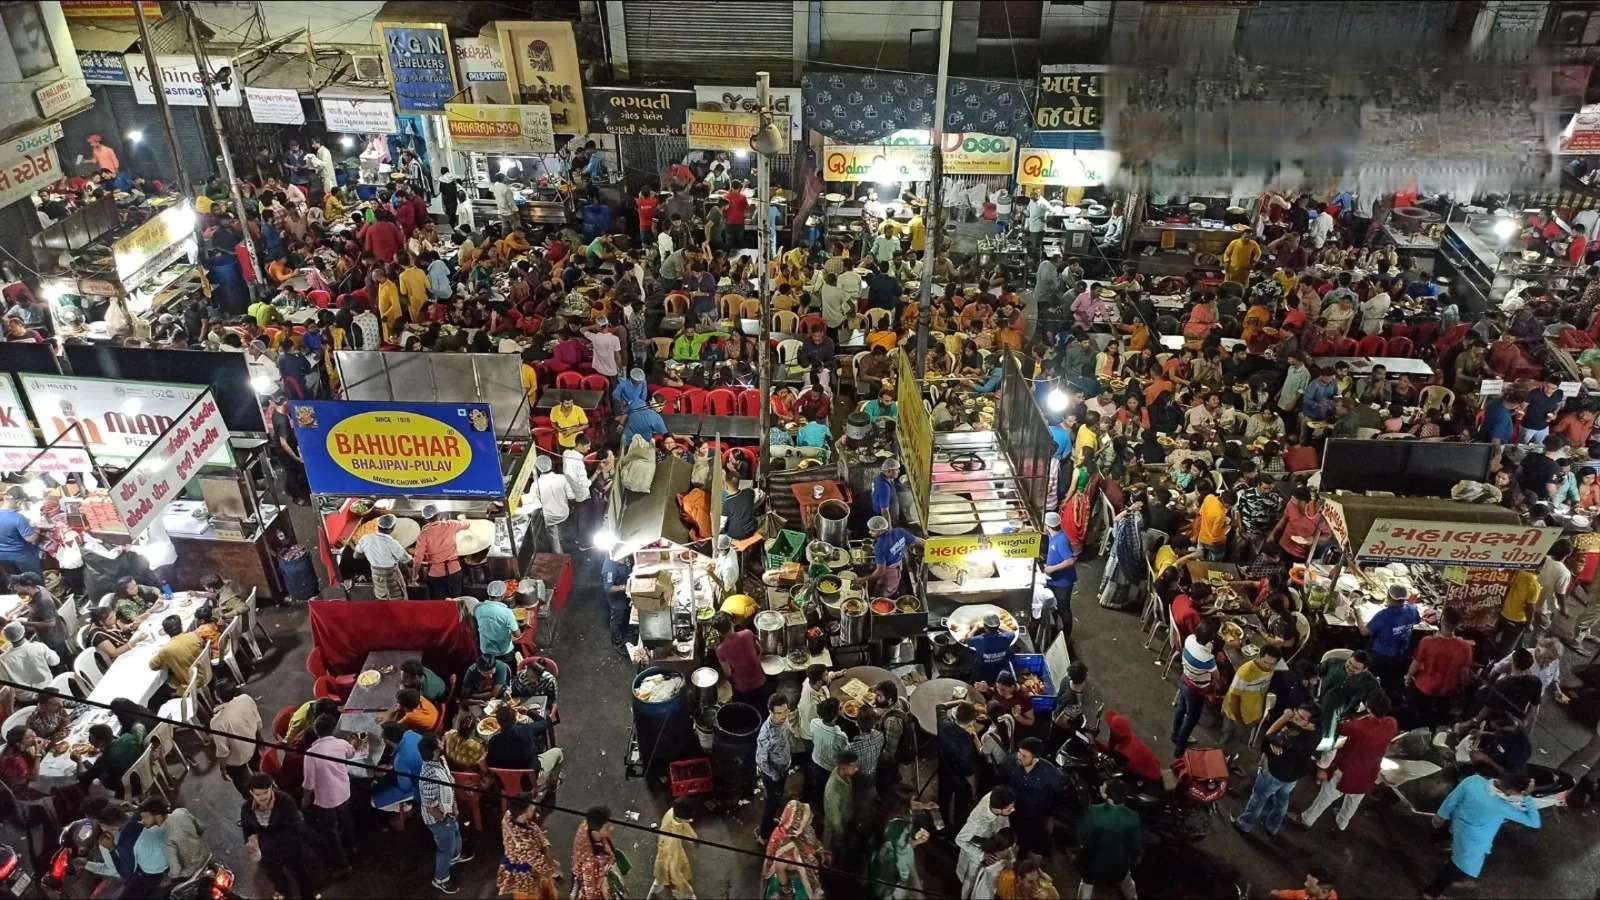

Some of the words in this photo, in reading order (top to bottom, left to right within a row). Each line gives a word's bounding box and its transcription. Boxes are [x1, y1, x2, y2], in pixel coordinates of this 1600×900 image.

[394, 58, 445, 70] JEWELLERS
[609, 93, 671, 110] ભગવતી
[450, 122, 495, 135] MAHARAJA
[497, 122, 519, 134] DOSA
[691, 123, 735, 136] MAHARAJA
[12, 147, 53, 184] સ્ટોર્સ
[335, 432, 461, 457] BAHUCHAR
[352, 458, 452, 472] BHAJIPAV-PULAV
[420, 475, 437, 484] WALA
[1391, 526, 1543, 548] મહાલક્ષ્મી
[1450, 545, 1491, 560] એન્ડ
